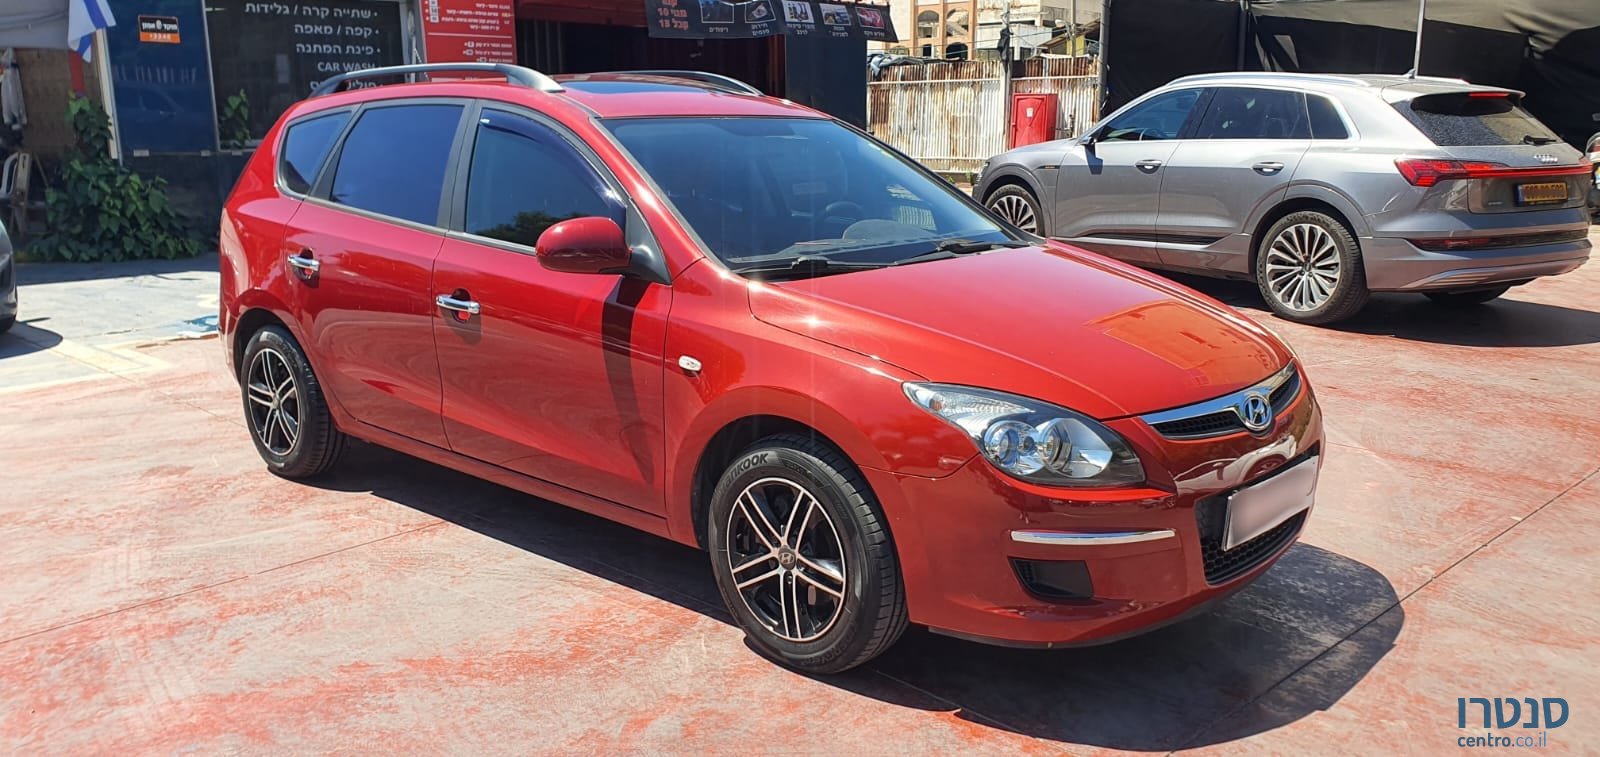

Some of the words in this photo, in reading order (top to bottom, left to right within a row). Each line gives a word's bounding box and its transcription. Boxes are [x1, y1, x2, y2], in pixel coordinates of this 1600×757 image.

[244, 2, 290, 15] גלידות
[302, 5, 330, 19] קרה
[333, 7, 371, 19] שתייה
[294, 24, 333, 35] מאפה
[345, 26, 373, 38] קפה
[296, 43, 341, 54] המתנה
[345, 44, 374, 55] פינת
[317, 62, 340, 72] CAR
